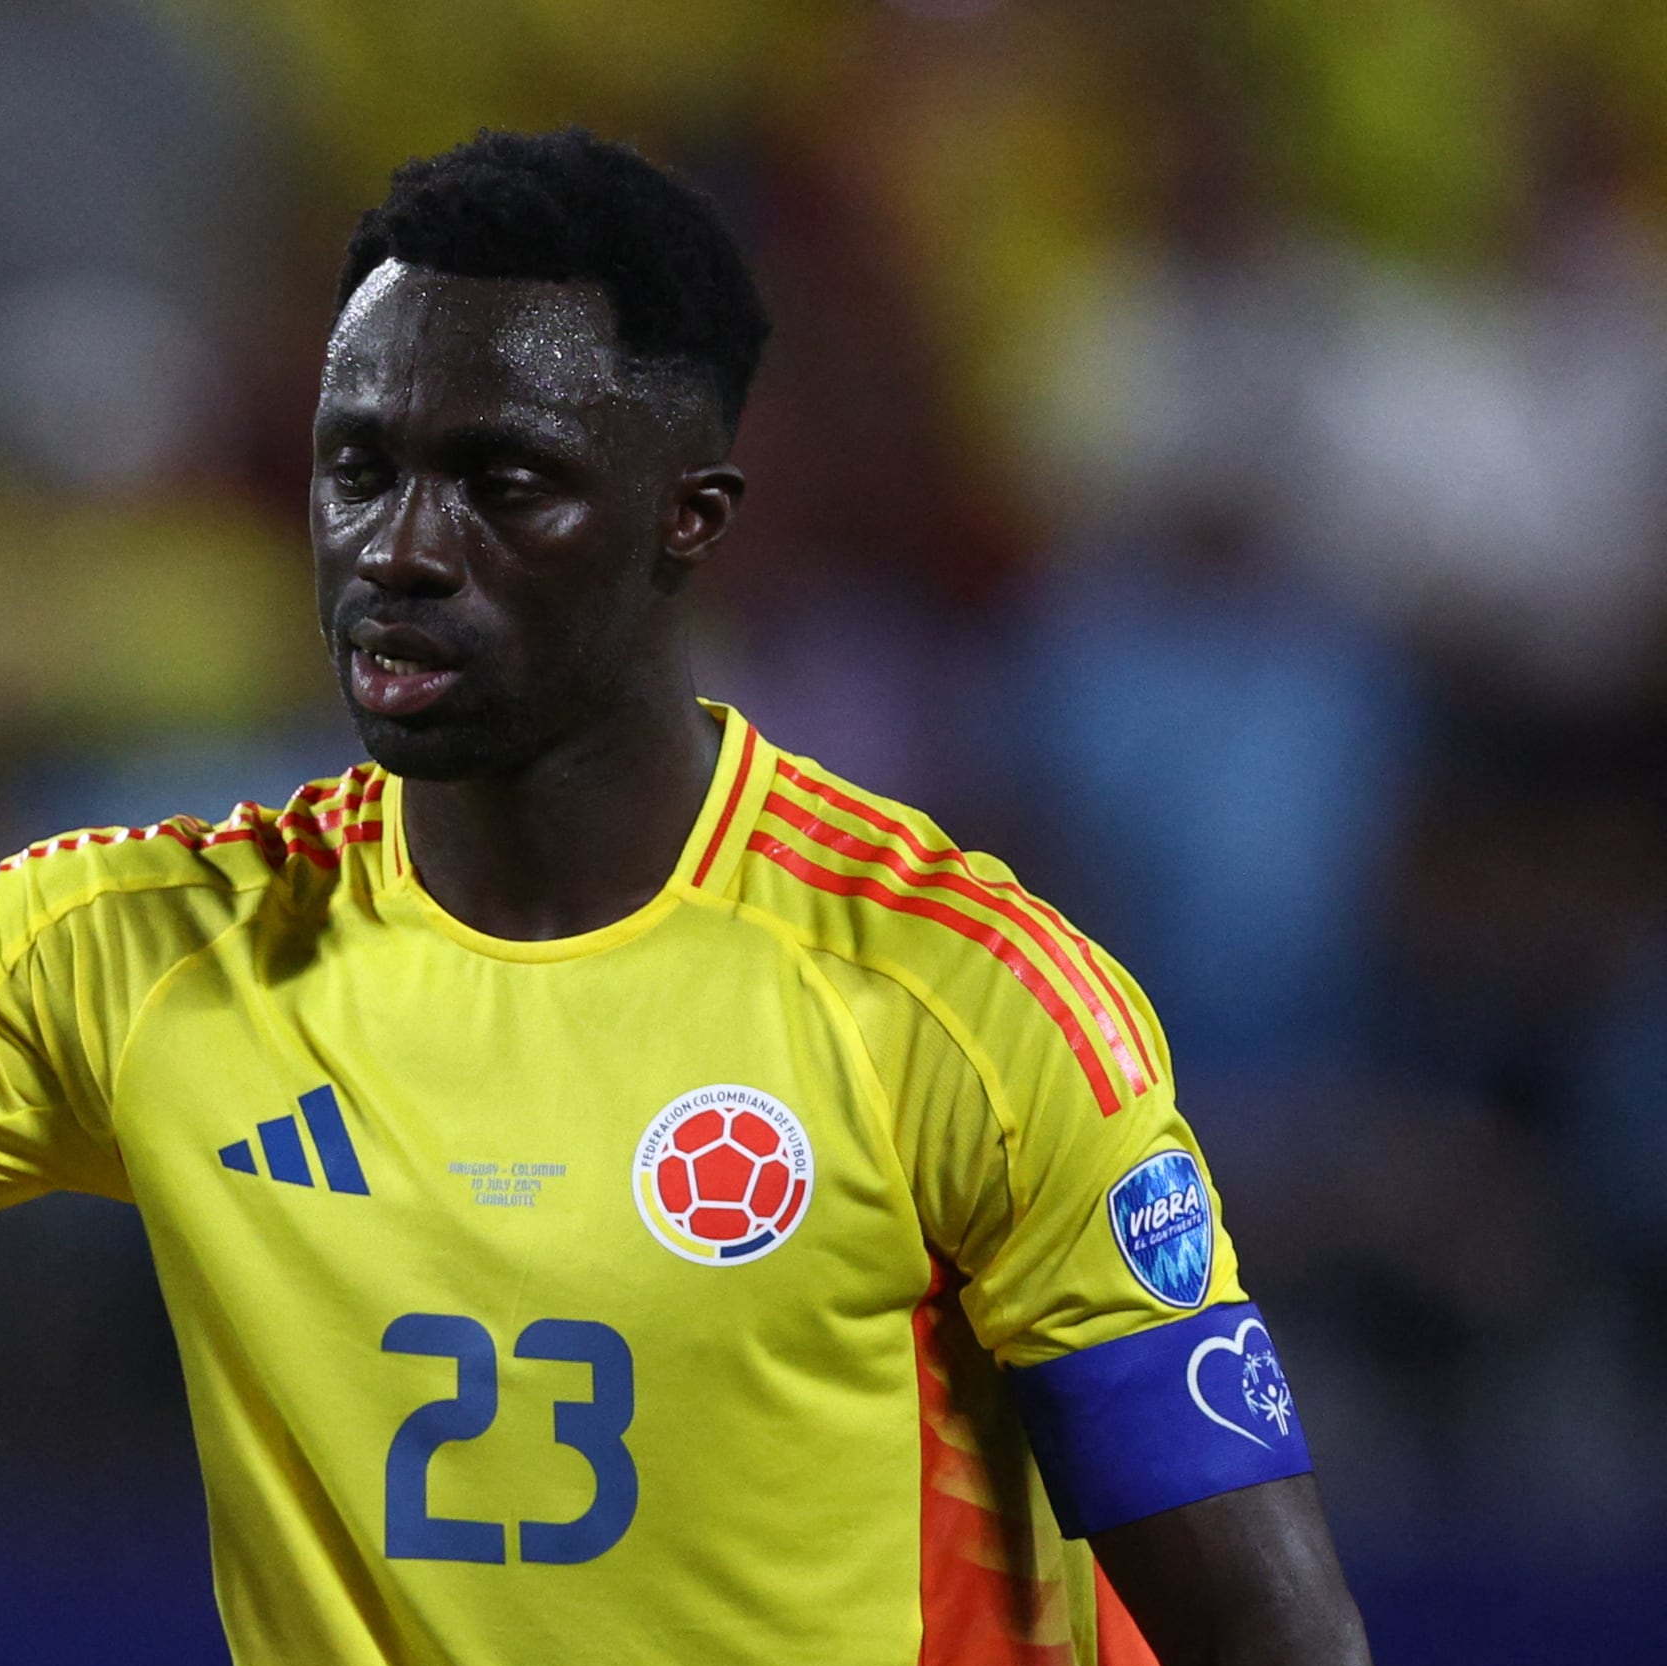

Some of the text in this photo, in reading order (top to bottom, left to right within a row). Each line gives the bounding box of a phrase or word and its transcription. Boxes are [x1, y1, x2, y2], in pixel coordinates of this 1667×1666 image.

[693, 1090, 775, 1116] COLOMBIANA
[774, 1111, 790, 1128] DE
[511, 1163, 567, 1177] COLOMBIA
[1130, 1183, 1199, 1238] VIBRA
[1134, 1211, 1202, 1251] EL CONTINENTE
[380, 1311, 639, 1566] 23
